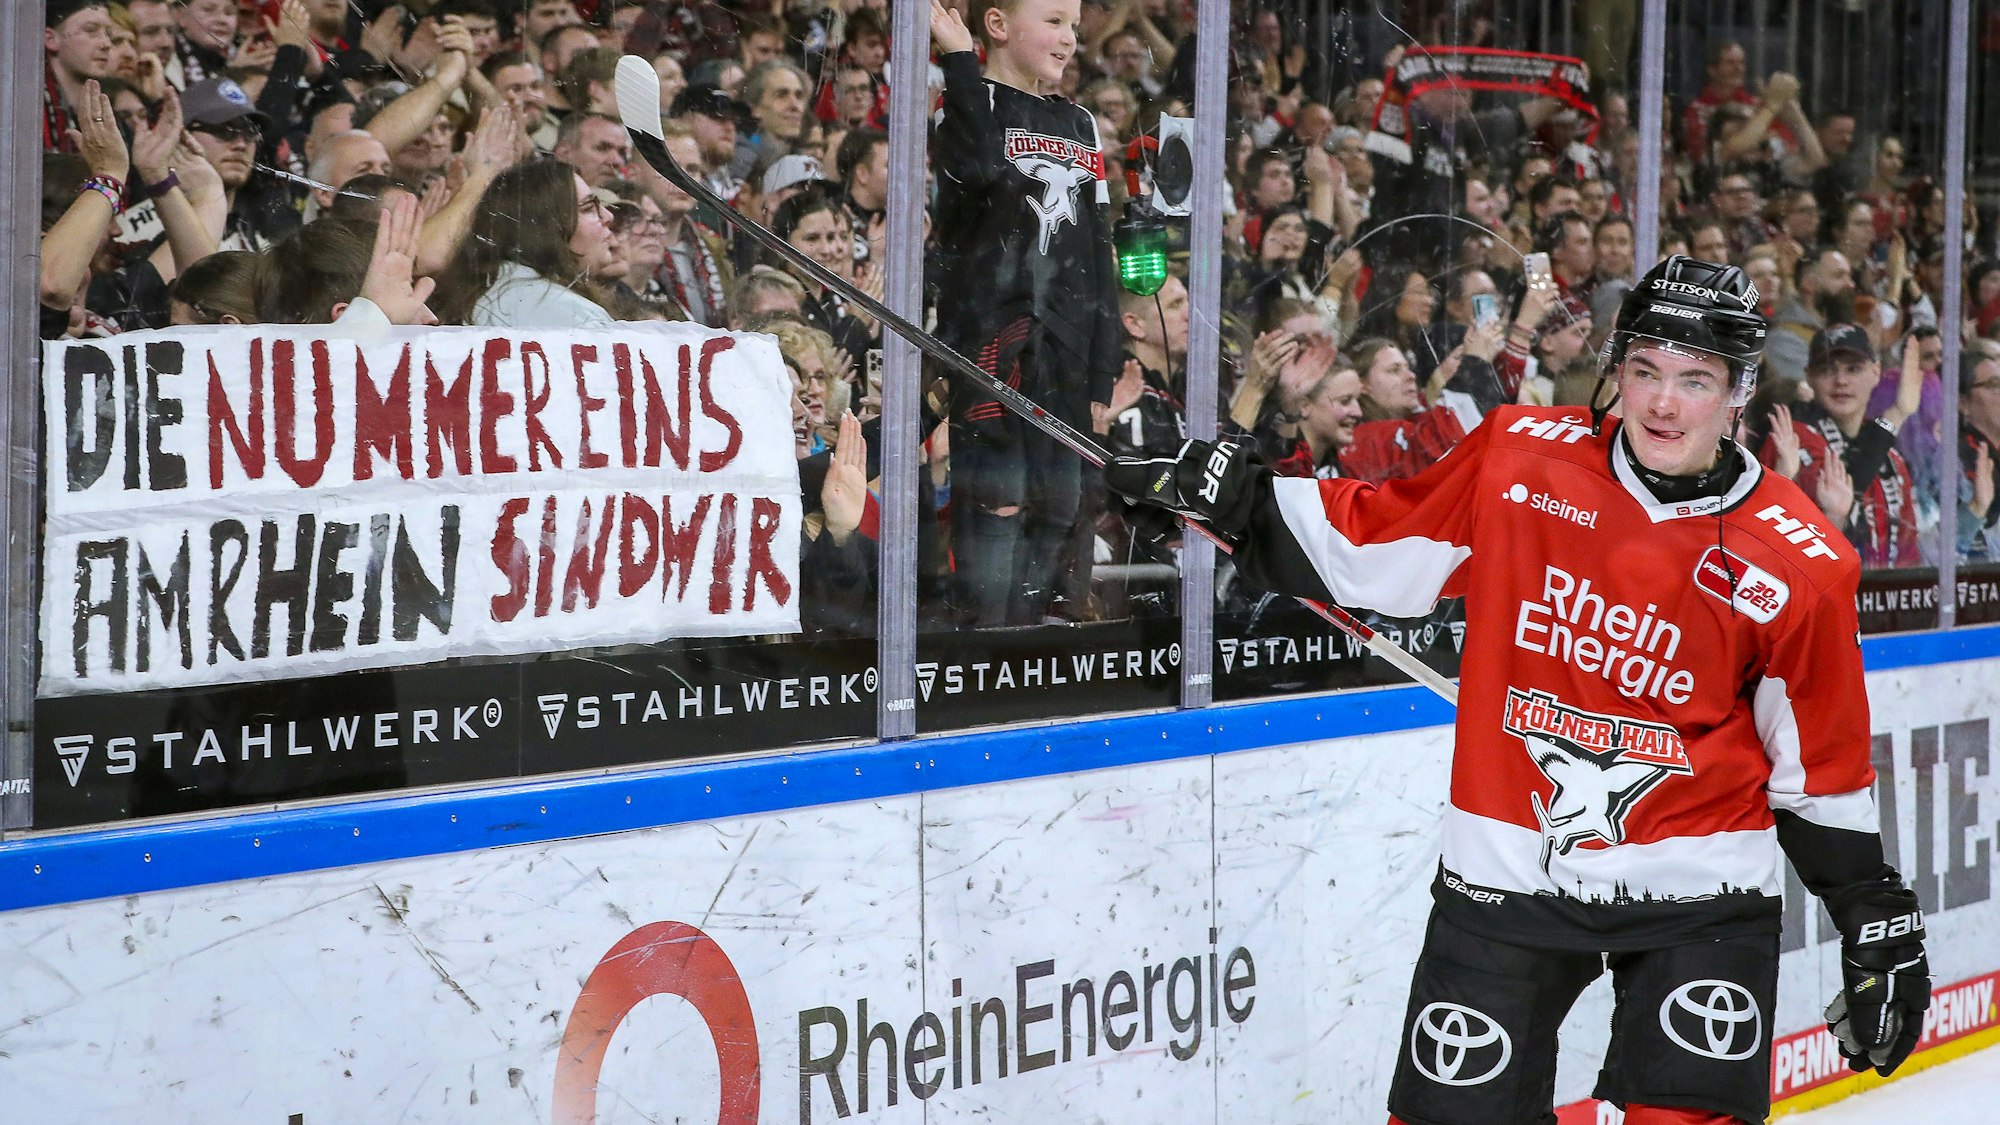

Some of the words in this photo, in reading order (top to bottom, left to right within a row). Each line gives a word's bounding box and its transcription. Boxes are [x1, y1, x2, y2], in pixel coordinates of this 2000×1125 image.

[64, 341, 188, 492] DIE
[1198, 441, 1240, 504] UER
[1530, 492, 1599, 529] steinel
[1703, 561, 1739, 585] PENN
[1750, 580, 1777, 599] 30
[1543, 564, 1682, 661] Rhein
[1515, 600, 1695, 705] Energie
[1508, 693, 1612, 750] KÖLNER
[1620, 724, 1688, 762] HAIE
[1857, 909, 1927, 945] BAU
[799, 926, 1257, 1125] RheinEnergie
